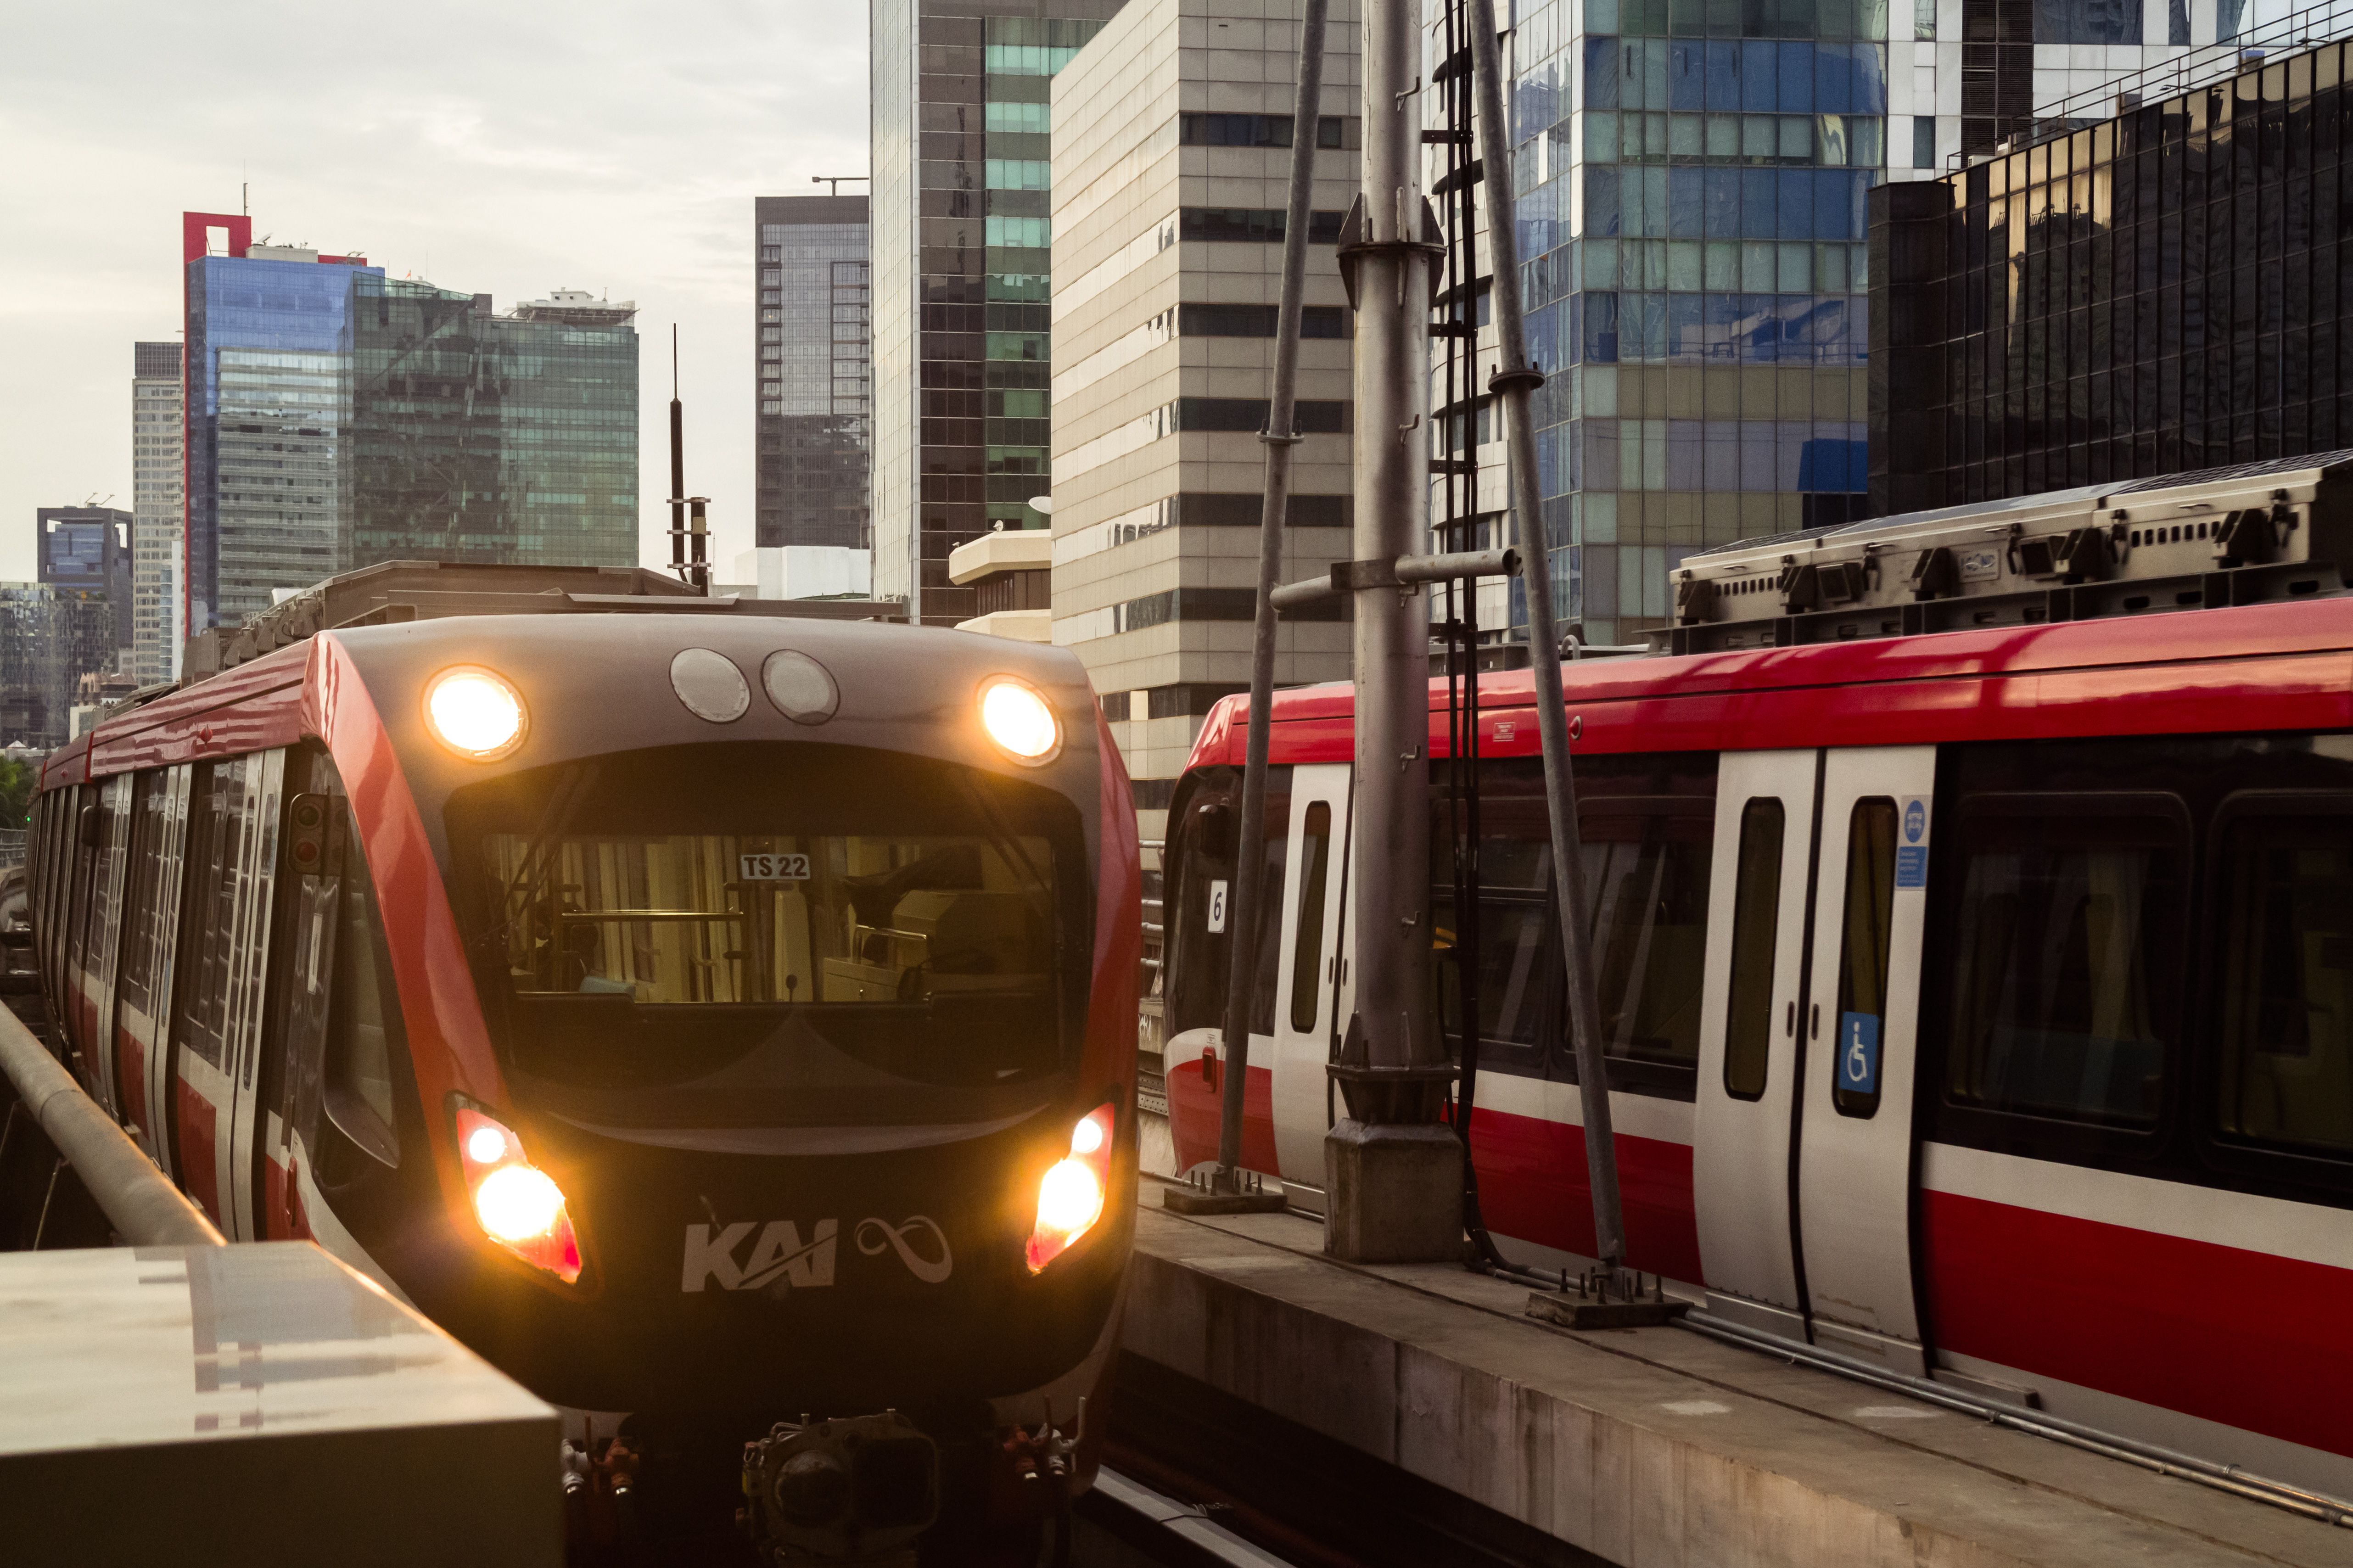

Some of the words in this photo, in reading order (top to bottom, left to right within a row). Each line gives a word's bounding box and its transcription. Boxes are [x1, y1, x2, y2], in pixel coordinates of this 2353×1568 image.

[744, 857, 773, 876] TS
[778, 857, 807, 876] 22
[1214, 892, 1222, 921] 6
[681, 1219, 838, 1293] KAI
